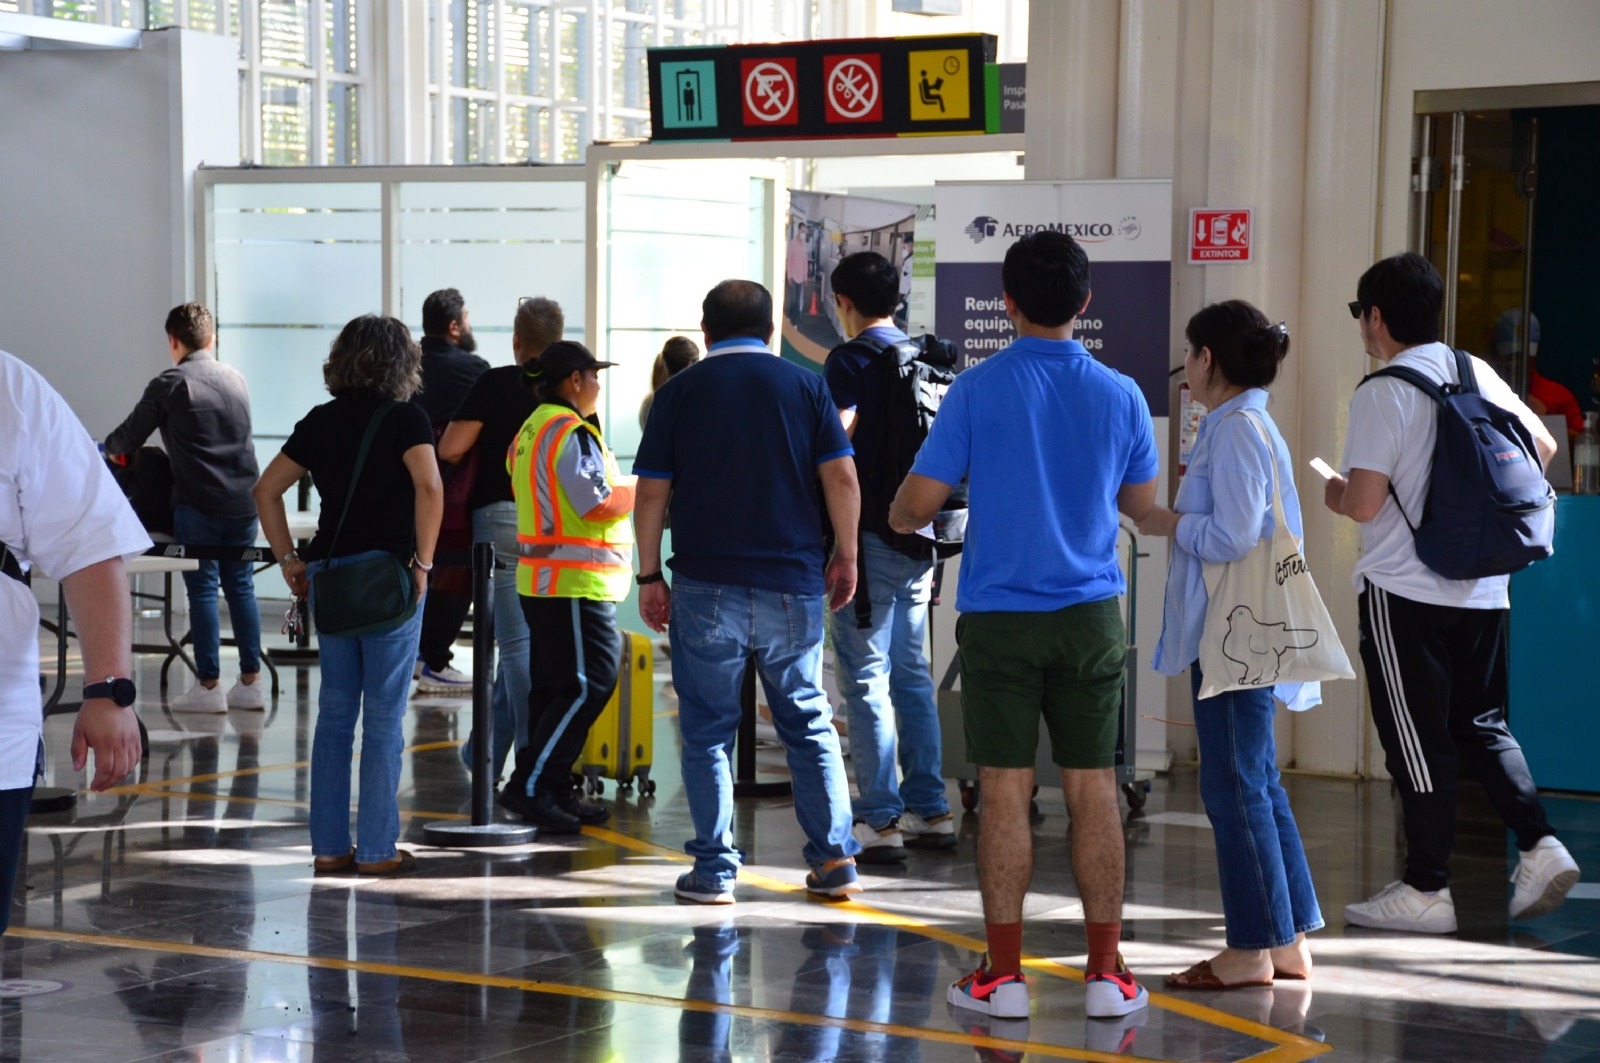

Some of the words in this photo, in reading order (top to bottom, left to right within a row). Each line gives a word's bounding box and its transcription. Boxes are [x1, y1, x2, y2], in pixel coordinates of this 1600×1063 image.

[1003, 85, 1026, 97] Insp
[1003, 99, 1025, 109] Pasa
[1199, 250, 1241, 259] EXTINTOR
[965, 296, 1007, 311] Revis
[1073, 318, 1103, 330] ano
[965, 335, 1013, 350] cumpl
